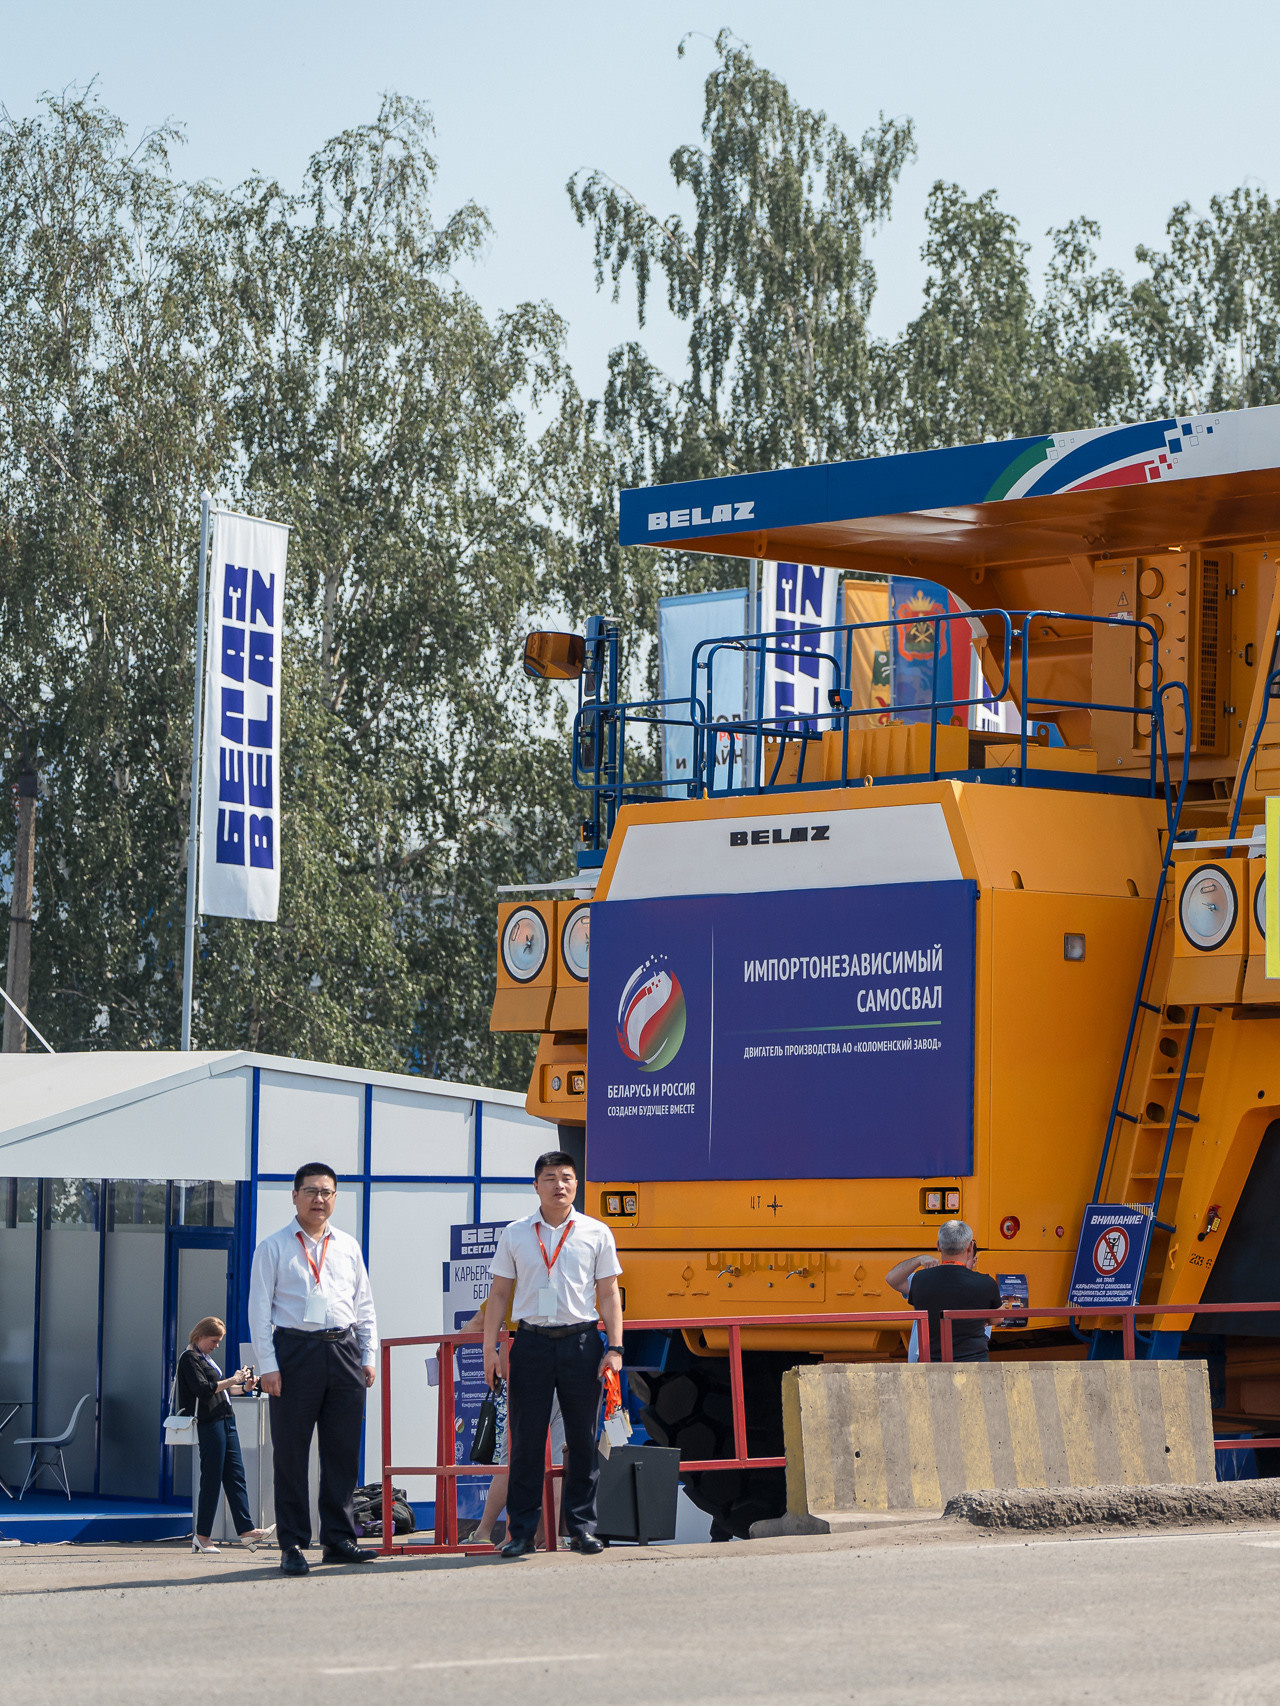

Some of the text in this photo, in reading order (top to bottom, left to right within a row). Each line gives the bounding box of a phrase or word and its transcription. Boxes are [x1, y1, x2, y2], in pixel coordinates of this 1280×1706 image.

[648, 501, 755, 531] BELAZ
[216, 563, 249, 866] БЕЛАЗ
[248, 569, 275, 870] BELAZ
[730, 825, 830, 846] BELAZ
[744, 943, 943, 983] ИМПОРТОНЕЗАВИСИМЫЙ
[857, 985, 942, 1013] САМОСВАЛ
[744, 1037, 942, 1059] ДВИГАТЕЛЬ ПРОИЗВОДСТВА АО «КОЛОМЕНСКИЙ ЗАВОД»
[607, 1082, 695, 1099] БЕЛАРУСЬ И РОССИЯ
[607, 1103, 695, 1117] СОЗДАЕМ БУДУЩЕЕ ВМЕСТЕ
[1090, 1214, 1144, 1225] ВНИМАНИЕ!
[461, 1244, 496, 1255] ВСЕГДА
[454, 1265, 494, 1282] КАРЬЕРН
